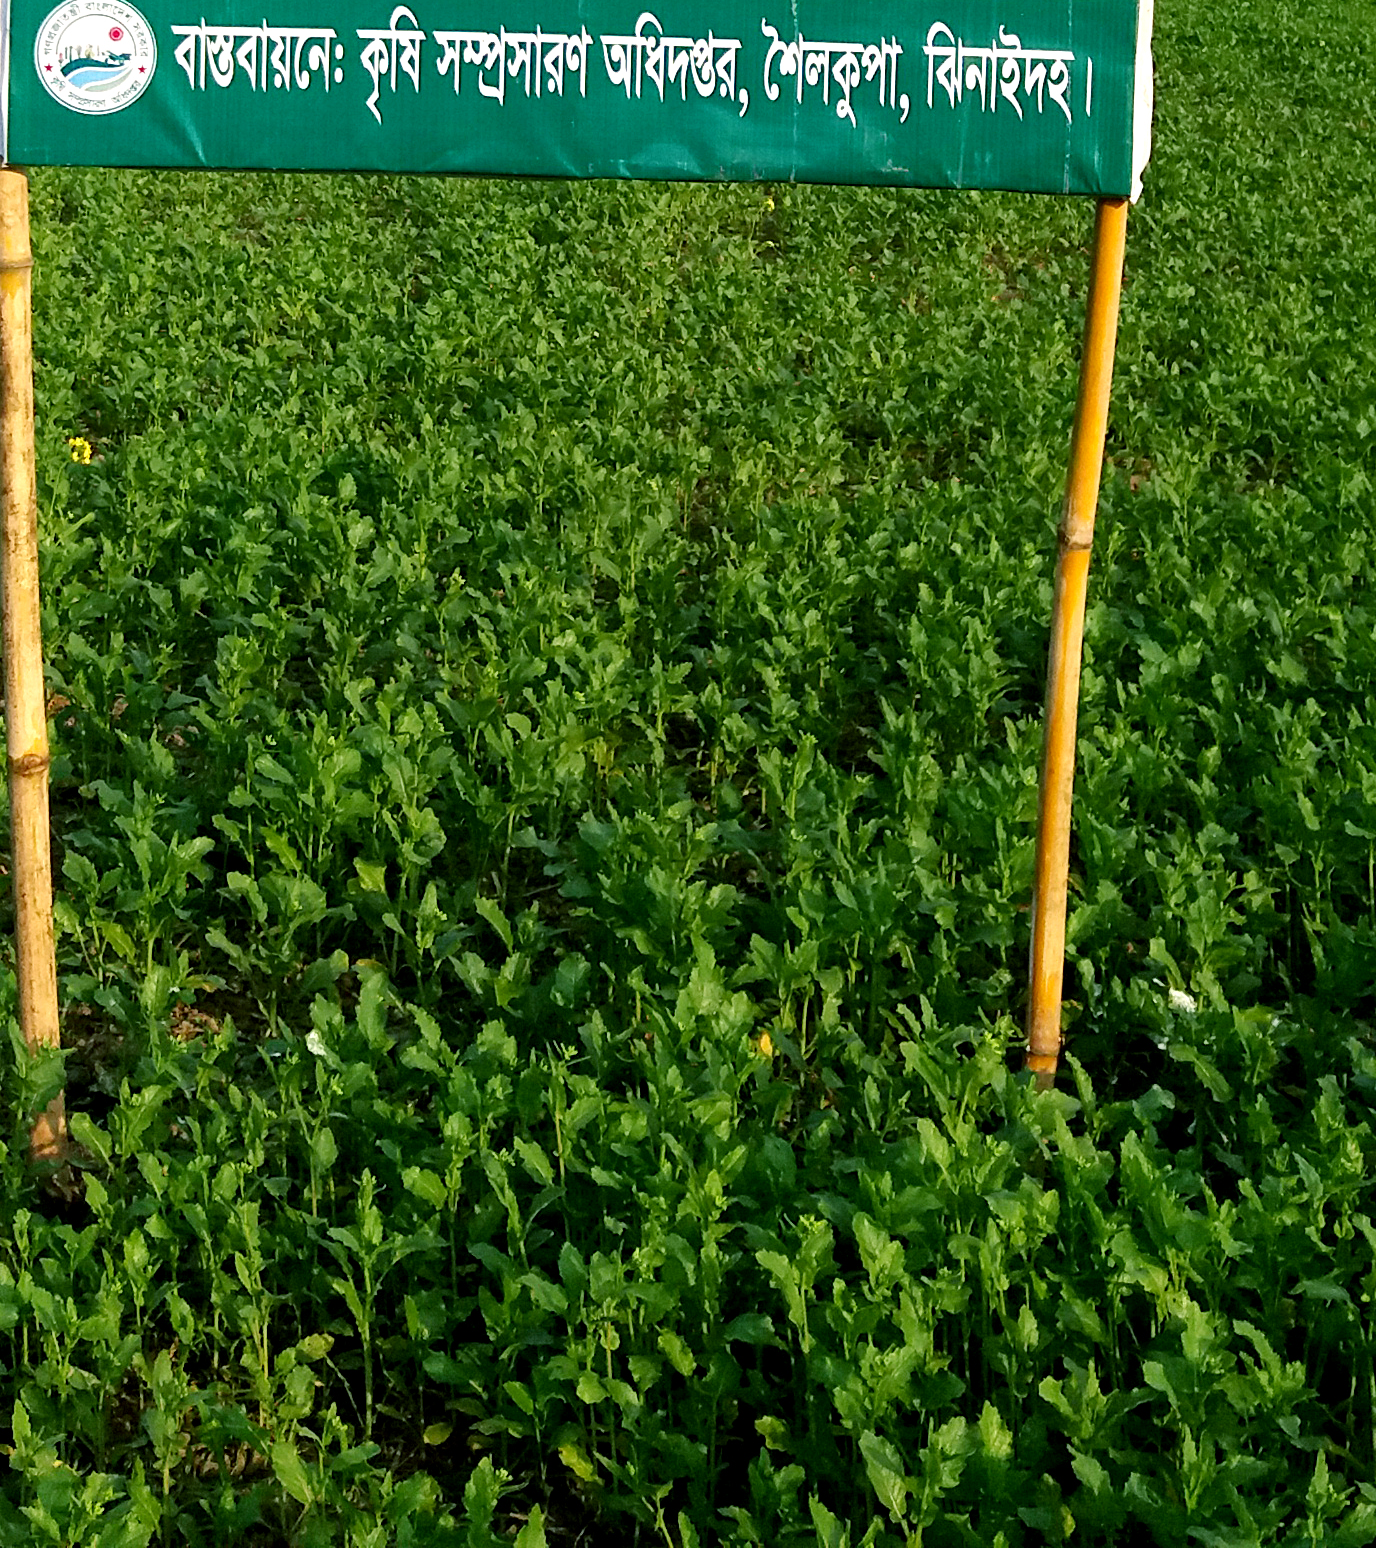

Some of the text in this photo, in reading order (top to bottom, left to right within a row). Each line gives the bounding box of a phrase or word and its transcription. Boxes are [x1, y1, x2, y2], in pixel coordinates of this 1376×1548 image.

[170, 17, 344, 93] বাস্তবায়নে:
[355, 5, 427, 124] কৃষি
[432, 24, 594, 106] সম্প্রসারণ
[599, 12, 749, 117] অধিদপ্তর,
[761, 17, 910, 128] শৈলকুপা,
